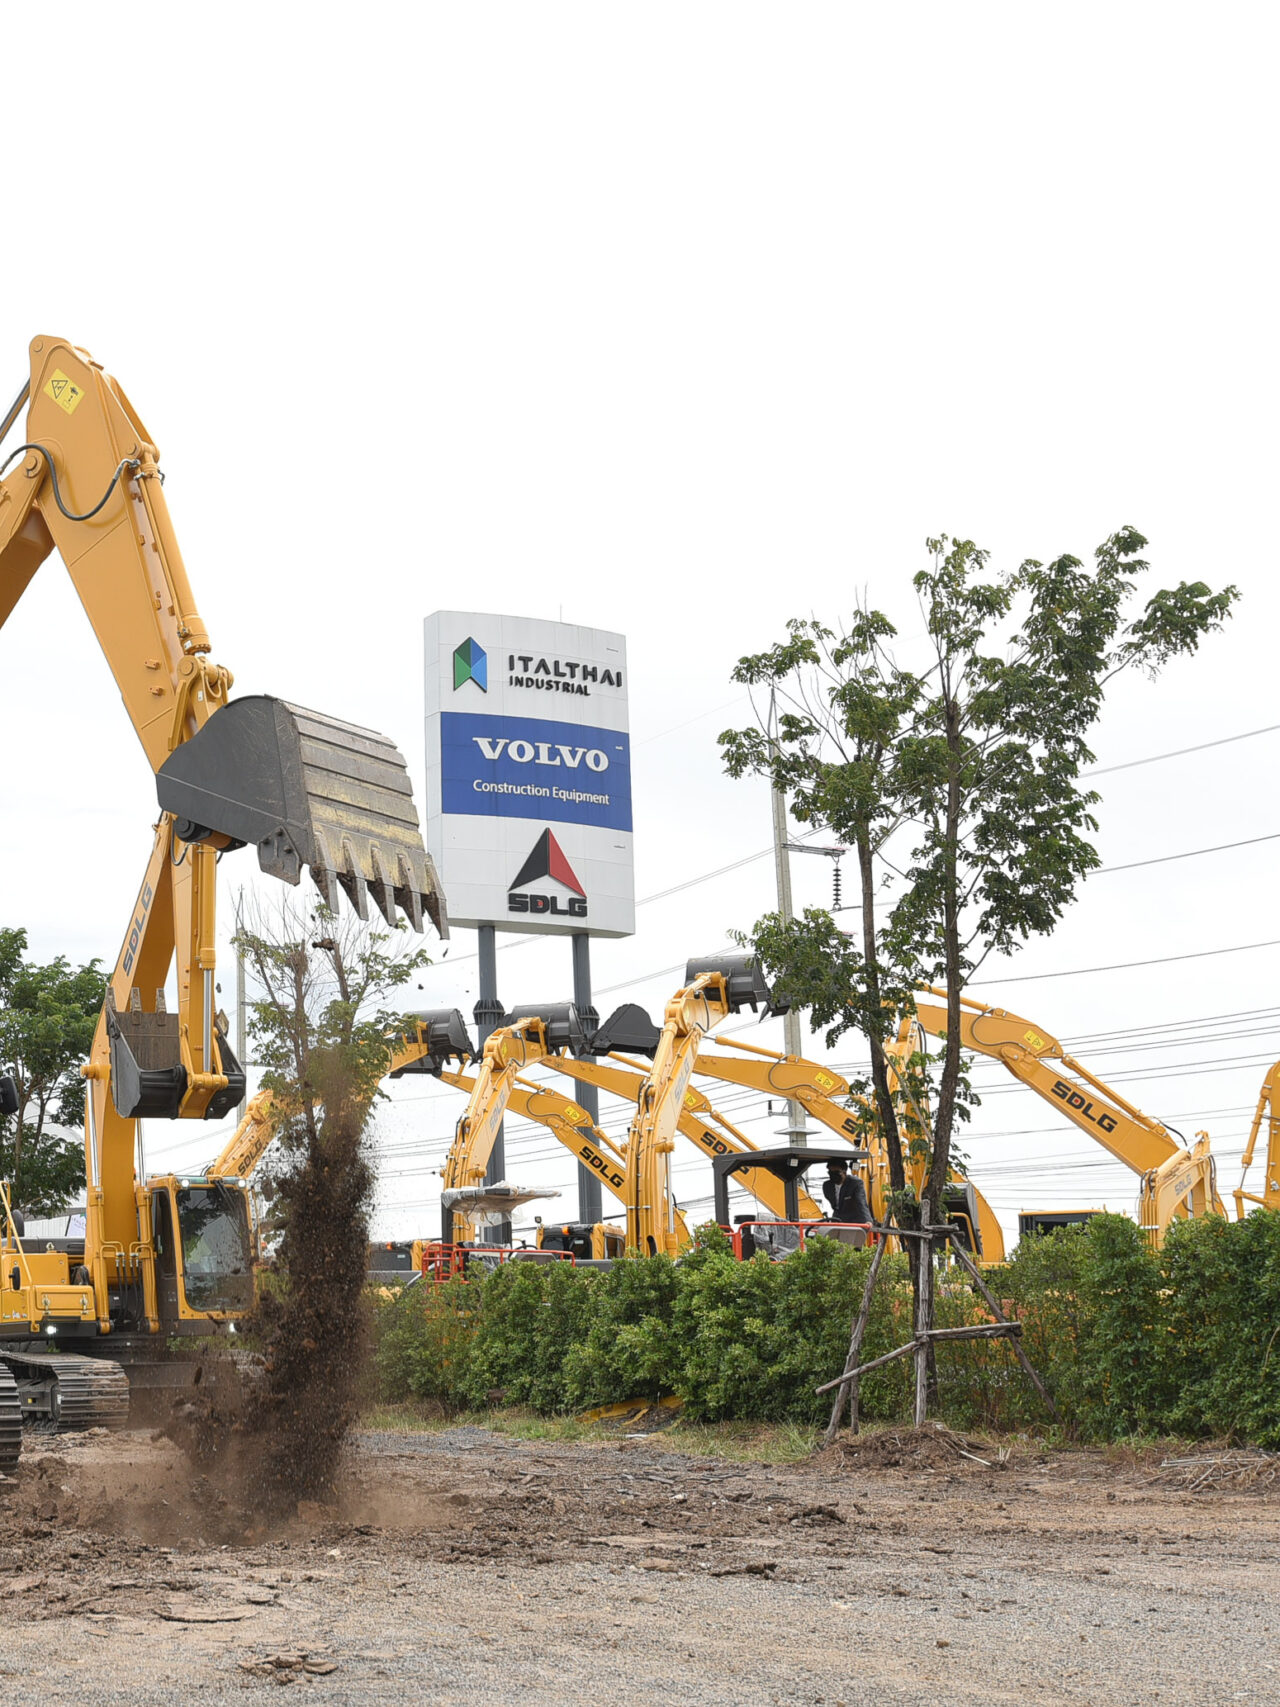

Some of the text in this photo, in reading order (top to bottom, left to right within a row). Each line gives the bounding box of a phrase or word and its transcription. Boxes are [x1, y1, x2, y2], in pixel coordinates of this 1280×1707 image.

[508, 655, 623, 688] ITALTHAI
[509, 675, 591, 696] INDUSTRIAL
[472, 736, 609, 773] VOLVO
[473, 779, 610, 805] Construction Equipment
[508, 892, 588, 918] SDLG
[122, 881, 152, 977] SDLG
[1050, 1080, 1118, 1133] SDLG
[579, 1146, 624, 1188] SDLG
